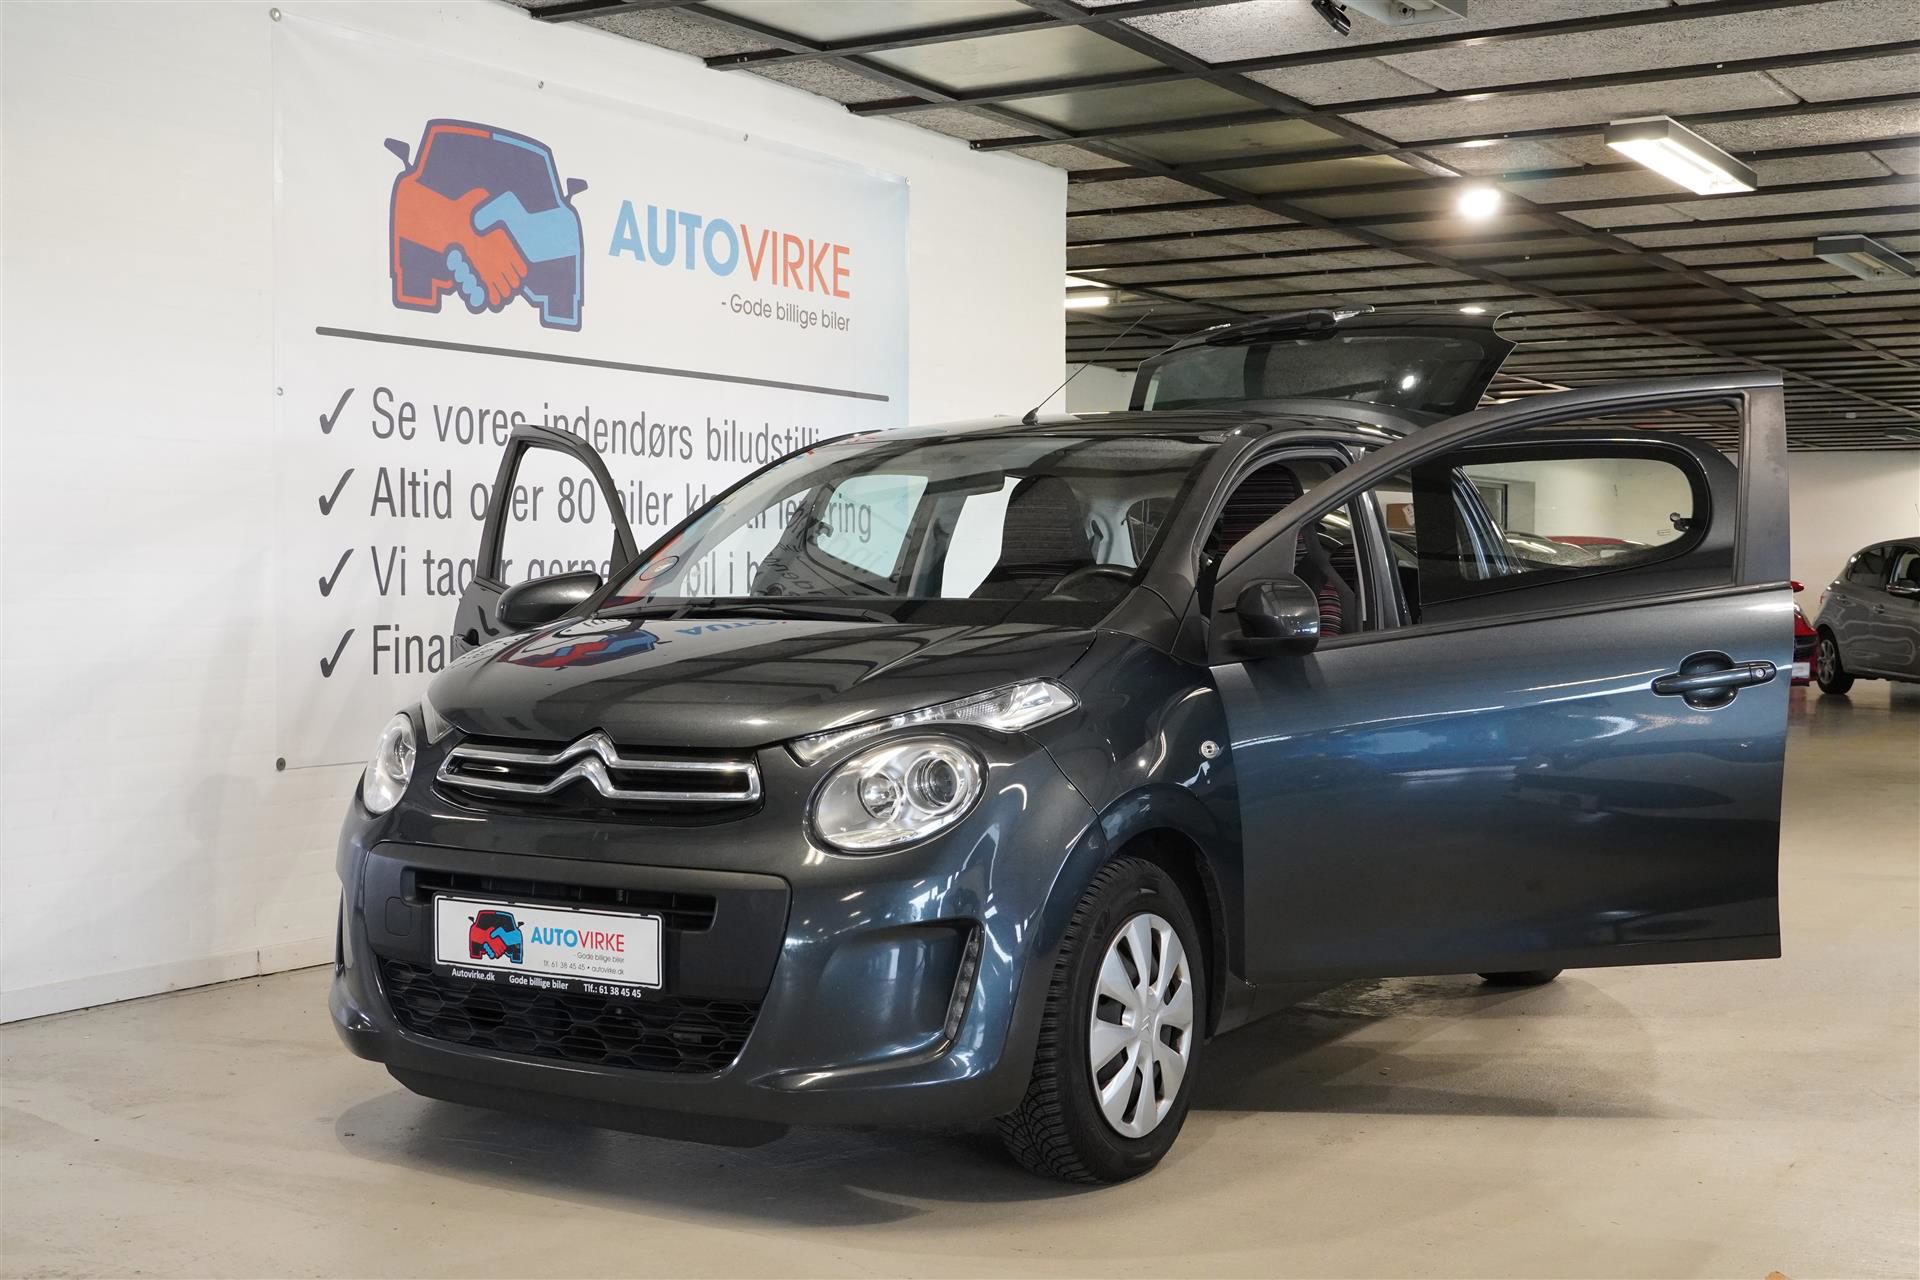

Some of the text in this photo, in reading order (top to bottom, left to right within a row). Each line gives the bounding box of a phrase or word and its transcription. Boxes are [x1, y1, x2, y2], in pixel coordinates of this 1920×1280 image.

[608, 200, 850, 299] AUTOVIRKE
[730, 294, 772, 319] Gode
[776, 301, 818, 329] billige
[821, 312, 851, 332] biler
[372, 386, 416, 440] Se
[370, 466, 452, 520] Altid
[470, 481, 544, 522] oer
[558, 476, 596, 524] 80
[371, 546, 406, 596] Vi
[422, 550, 513, 597] tagr
[531, 926, 625, 952] AUTOVIRKE
[451, 968, 496, 982] Autovirke.dk
[509, 975, 528, 985] Gode
[529, 977, 551, 989] billige
[552, 979, 569, 990] biler
[599, 985, 608, 995] 61
[610, 986, 620, 996] 38
[621, 987, 630, 997] 45
[632, 988, 642, 998] 45
